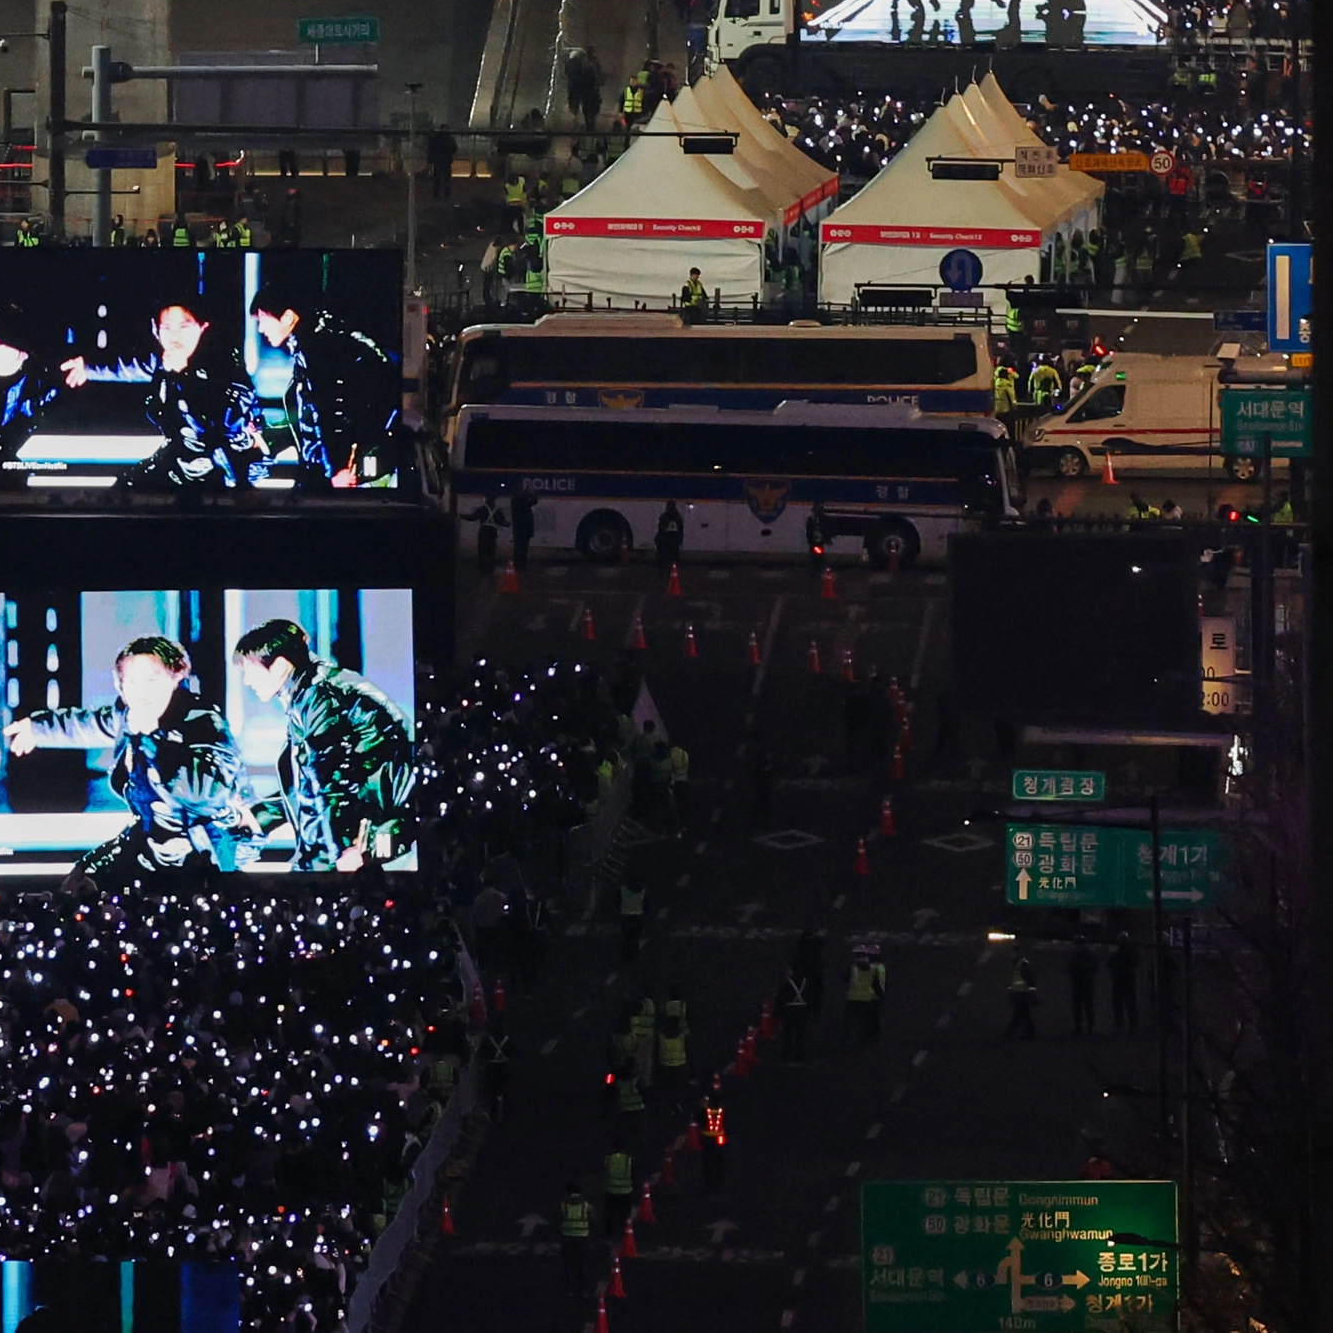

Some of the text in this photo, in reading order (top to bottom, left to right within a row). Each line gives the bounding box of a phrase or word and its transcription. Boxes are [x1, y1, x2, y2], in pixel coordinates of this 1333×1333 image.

[1153, 158, 1171, 169] 50
[1236, 400, 1305, 419] 서대문역
[522, 477, 576, 491] POLICE
[1016, 832, 1099, 853] 21 독립문
[1016, 853, 1097, 875] 50 광화문
[954, 1214, 1010, 1235] 광화문
[1021, 1211, 1072, 1229] 光化門
[1019, 1228, 1114, 1243] Gwanghwamun
[1097, 1251, 1169, 1273] 종로1가
[1098, 1275, 1133, 1289] Jongno
